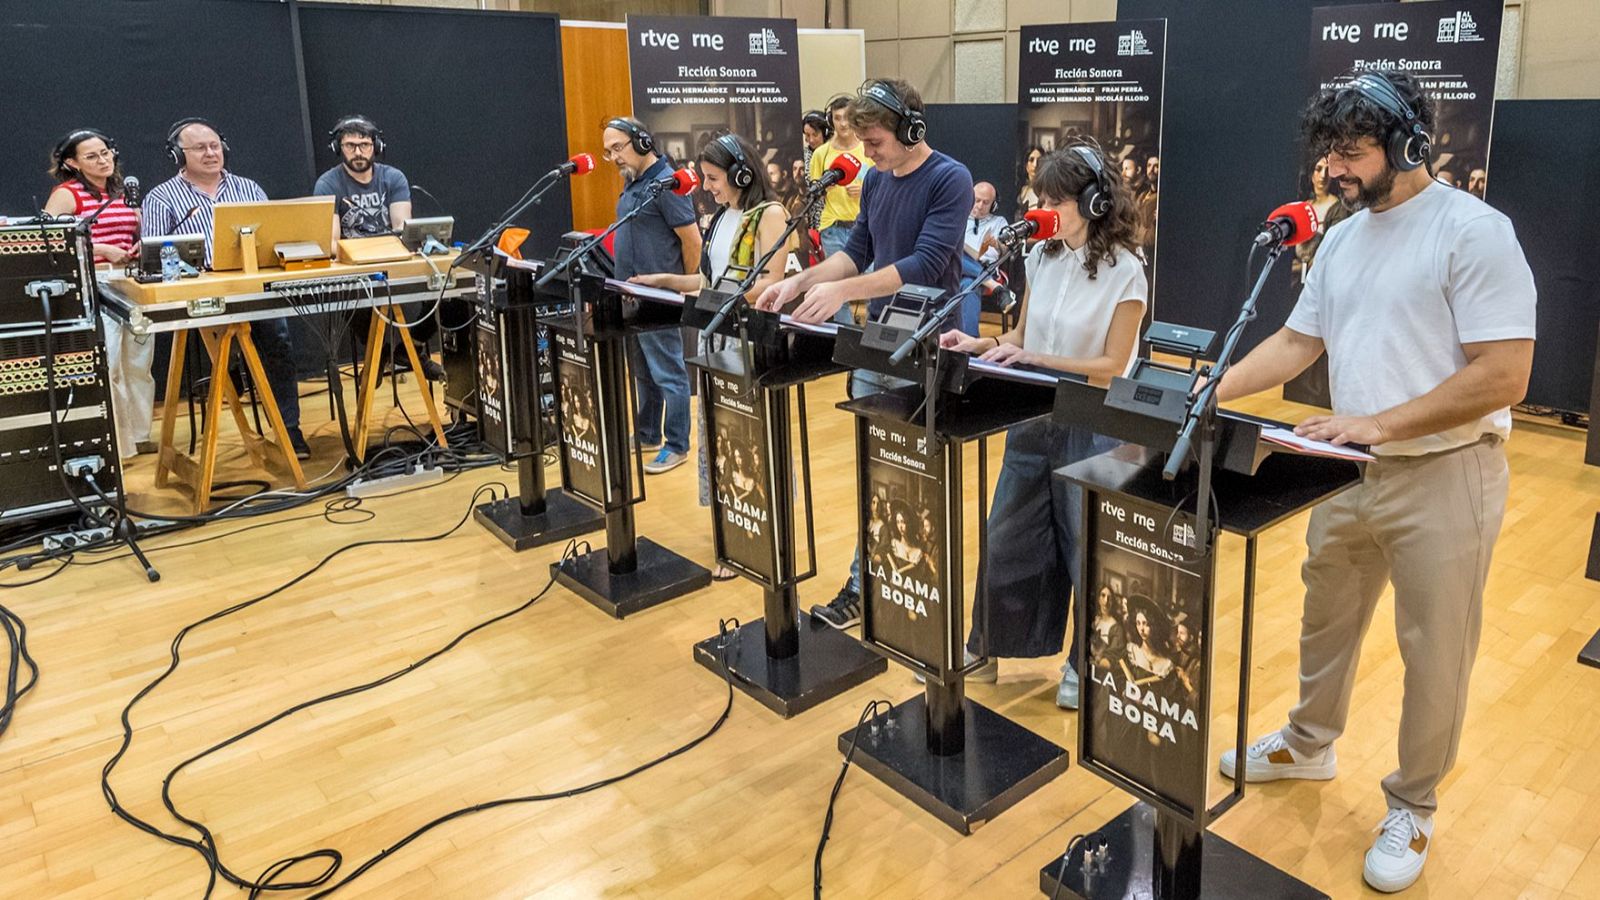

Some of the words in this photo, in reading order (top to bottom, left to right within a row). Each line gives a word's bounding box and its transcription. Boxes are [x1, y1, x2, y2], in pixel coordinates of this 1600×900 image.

[640, 29, 680, 50] rtve
[692, 33, 724, 51] rne
[1322, 22, 1361, 43] rtve
[1374, 22, 1408, 41] rne
[1029, 37, 1059, 55] rtve
[1069, 38, 1096, 54] rne
[678, 65, 718, 77] Ficción
[720, 66, 757, 77] Sonora
[1055, 67, 1088, 78] Ficción
[1089, 67, 1123, 78] Sonora
[1398, 58, 1442, 70] Sonora
[682, 86, 728, 94] HERNÁNDEZ
[1056, 86, 1095, 94] HERNÁNDEZ
[1095, 94, 1124, 102] NICOLÁS
[1304, 204, 1318, 232] rne
[563, 431, 574, 445] LA
[868, 424, 886, 441] rtve
[571, 447, 596, 468] BOBA
[880, 448, 902, 464] Ficción
[902, 456, 926, 470] Sonora
[717, 490, 730, 508] LA
[734, 496, 767, 522] DAMA
[1101, 500, 1126, 522] rtve
[1133, 512, 1156, 532] rne
[727, 509, 760, 536] BOBA
[1116, 530, 1148, 553] Ficción
[868, 560, 887, 582] LA
[892, 570, 940, 604] DAMA
[882, 584, 928, 618] BOBA
[1091, 664, 1117, 692] LA
[1126, 680, 1198, 732] DAMA
[1109, 694, 1177, 744] BOBA
